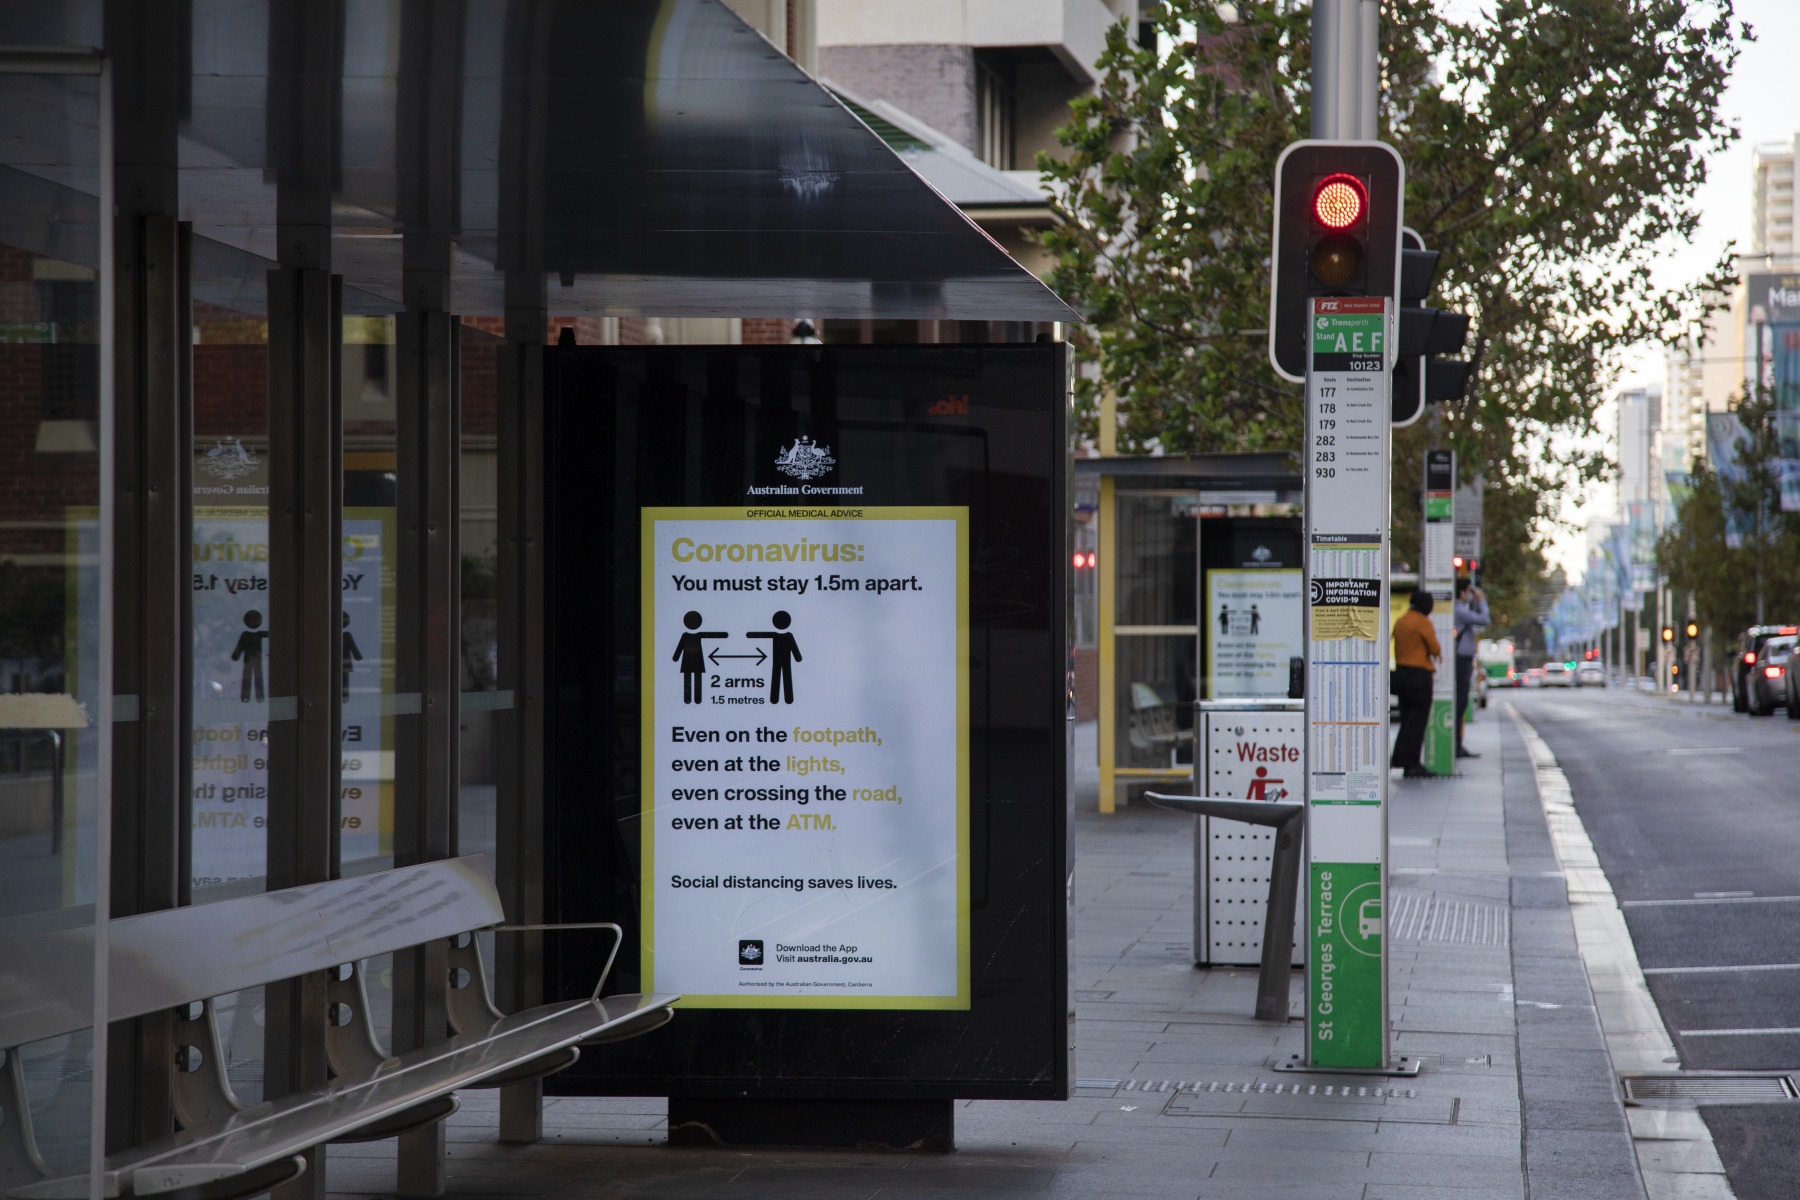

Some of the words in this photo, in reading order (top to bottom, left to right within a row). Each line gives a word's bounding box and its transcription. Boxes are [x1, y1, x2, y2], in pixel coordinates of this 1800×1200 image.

[1767, 286, 1800, 307] Ma
[1321, 301, 1339, 310] FTZ
[1331, 318, 1369, 327] Transperth
[1334, 332, 1347, 352] A
[1352, 332, 1363, 352] E
[1371, 332, 1382, 352] F
[1349, 360, 1381, 370] 10123
[1320, 387, 1336, 398] 177
[1319, 403, 1336, 414] 178
[1319, 419, 1336, 430] 179
[1316, 436, 1336, 446] 282
[1316, 452, 1336, 462] 283
[1316, 468, 1336, 478] 930
[747, 485, 799, 494] Australian
[801, 485, 863, 494] Government
[789, 509, 828, 517] MEDICAL
[672, 537, 864, 562] Coronavirus:
[672, 575, 707, 591] You
[713, 576, 762, 591] must
[767, 576, 809, 595] stay
[815, 575, 859, 591] 1.5m
[865, 576, 922, 595] apart.
[1326, 581, 1369, 589] IMPORTANT
[1326, 596, 1359, 604] COVID-19
[711, 675, 720, 687] 2
[725, 678, 764, 688] arms
[711, 696, 725, 704] 1.5
[728, 696, 764, 704] metres
[671, 727, 720, 743] Even
[725, 731, 750, 743] on
[755, 727, 788, 743] the
[793, 726, 882, 747] footpath,
[1236, 742, 1300, 763] Waste
[671, 759, 719, 772] even
[724, 757, 744, 772] at
[748, 756, 781, 772] the
[786, 755, 846, 776] lights,
[671, 789, 719, 801] even
[724, 785, 810, 805] crossing
[814, 785, 847, 801] the
[852, 785, 903, 805] road,
[671, 818, 719, 830] even
[724, 816, 744, 830] at
[748, 815, 781, 830] the
[786, 814, 837, 831] ATM.
[671, 875, 718, 888] Social
[723, 875, 803, 892] distancing
[808, 879, 853, 888] saves
[858, 876, 897, 889] lives.
[1318, 871, 1332, 937] Terrace
[776, 944, 820, 952] Download
[823, 944, 837, 952] the
[839, 944, 857, 953] App
[797, 955, 872, 964] australia.gov.au
[1319, 943, 1336, 1014] Georges
[1319, 1021, 1333, 1040] St
